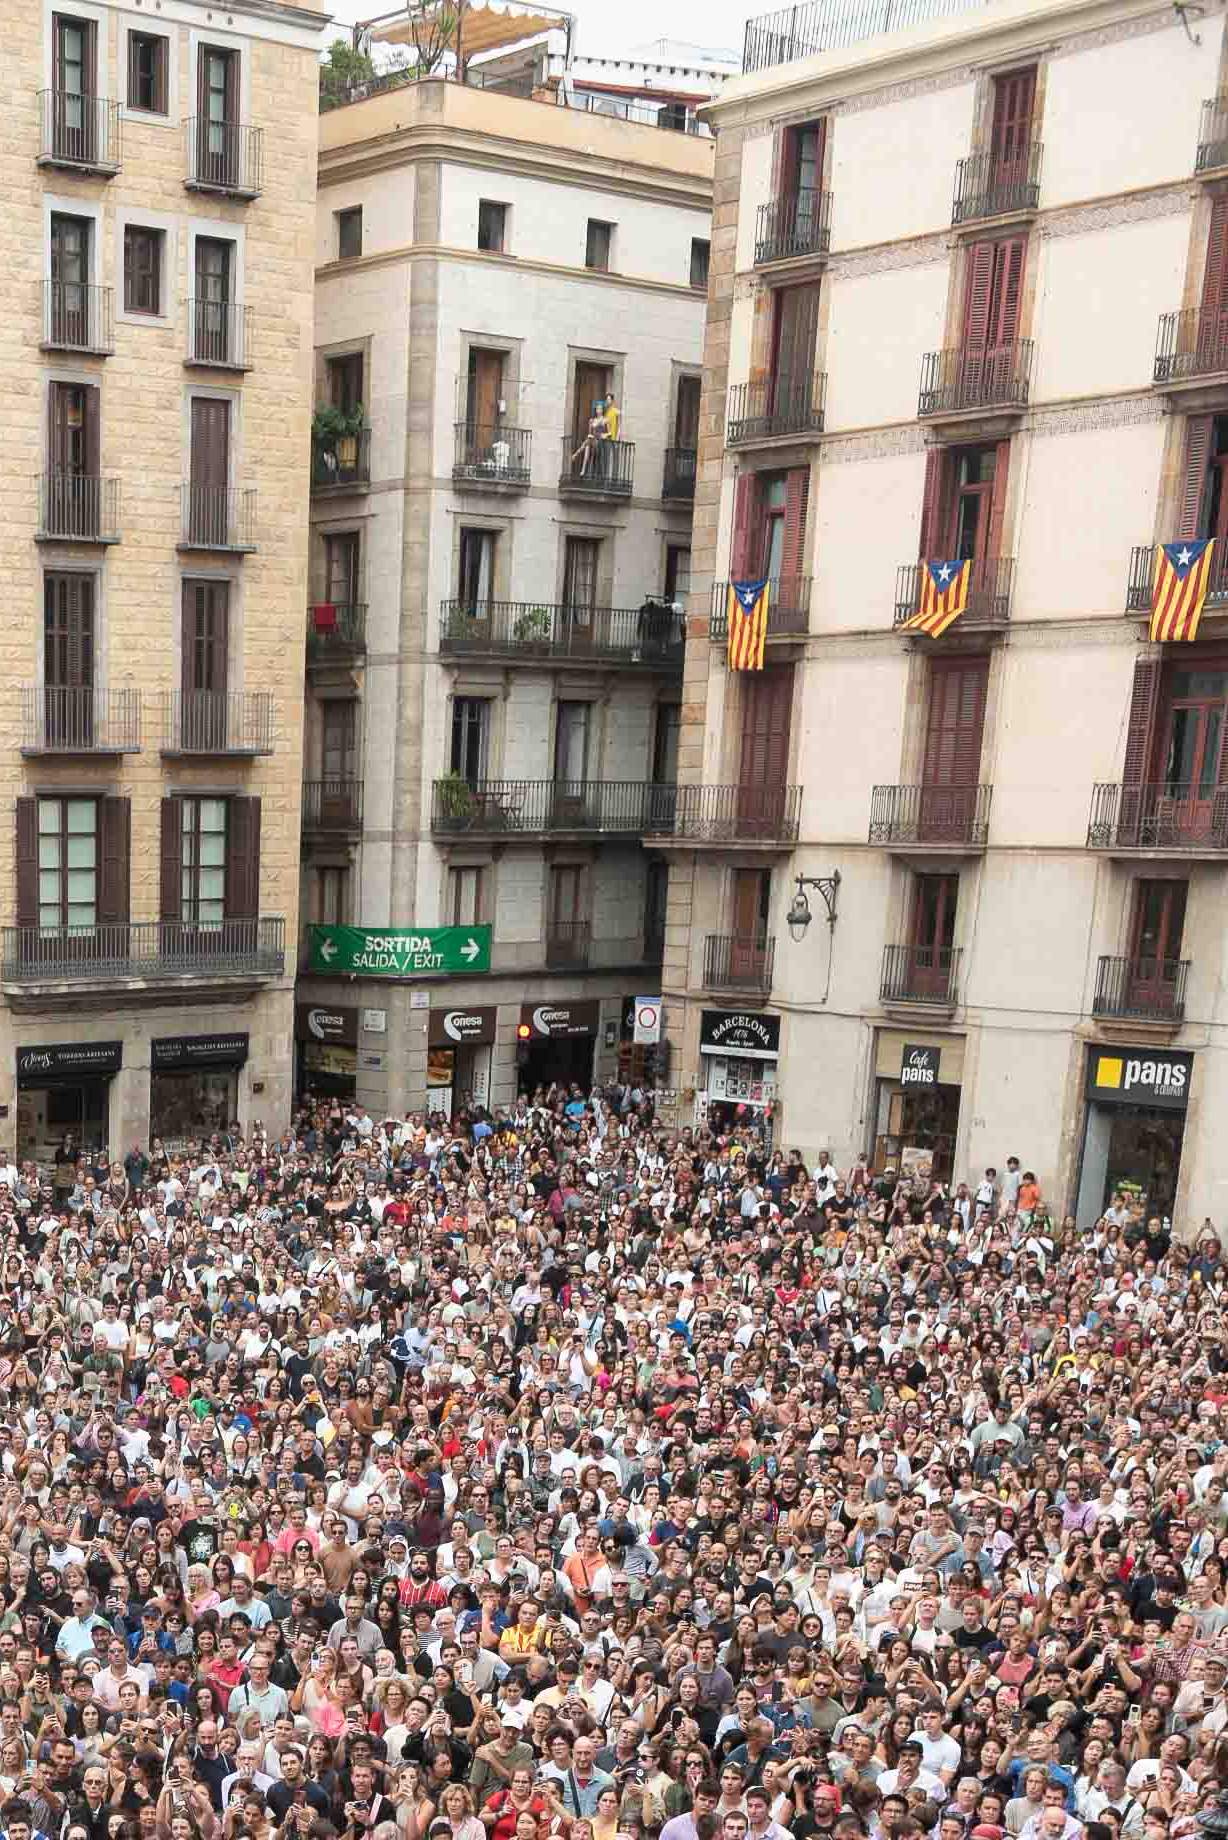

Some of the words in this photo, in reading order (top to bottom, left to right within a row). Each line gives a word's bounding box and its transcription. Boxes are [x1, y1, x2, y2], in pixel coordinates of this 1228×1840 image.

[365, 936, 432, 953] SORTIDA
[352, 953, 399, 969] SALIDA
[414, 954, 444, 968] EXIT
[712, 1015, 770, 1045] BARCELONA
[902, 1067, 934, 1085] pans
[1124, 1060, 1187, 1090] pans
